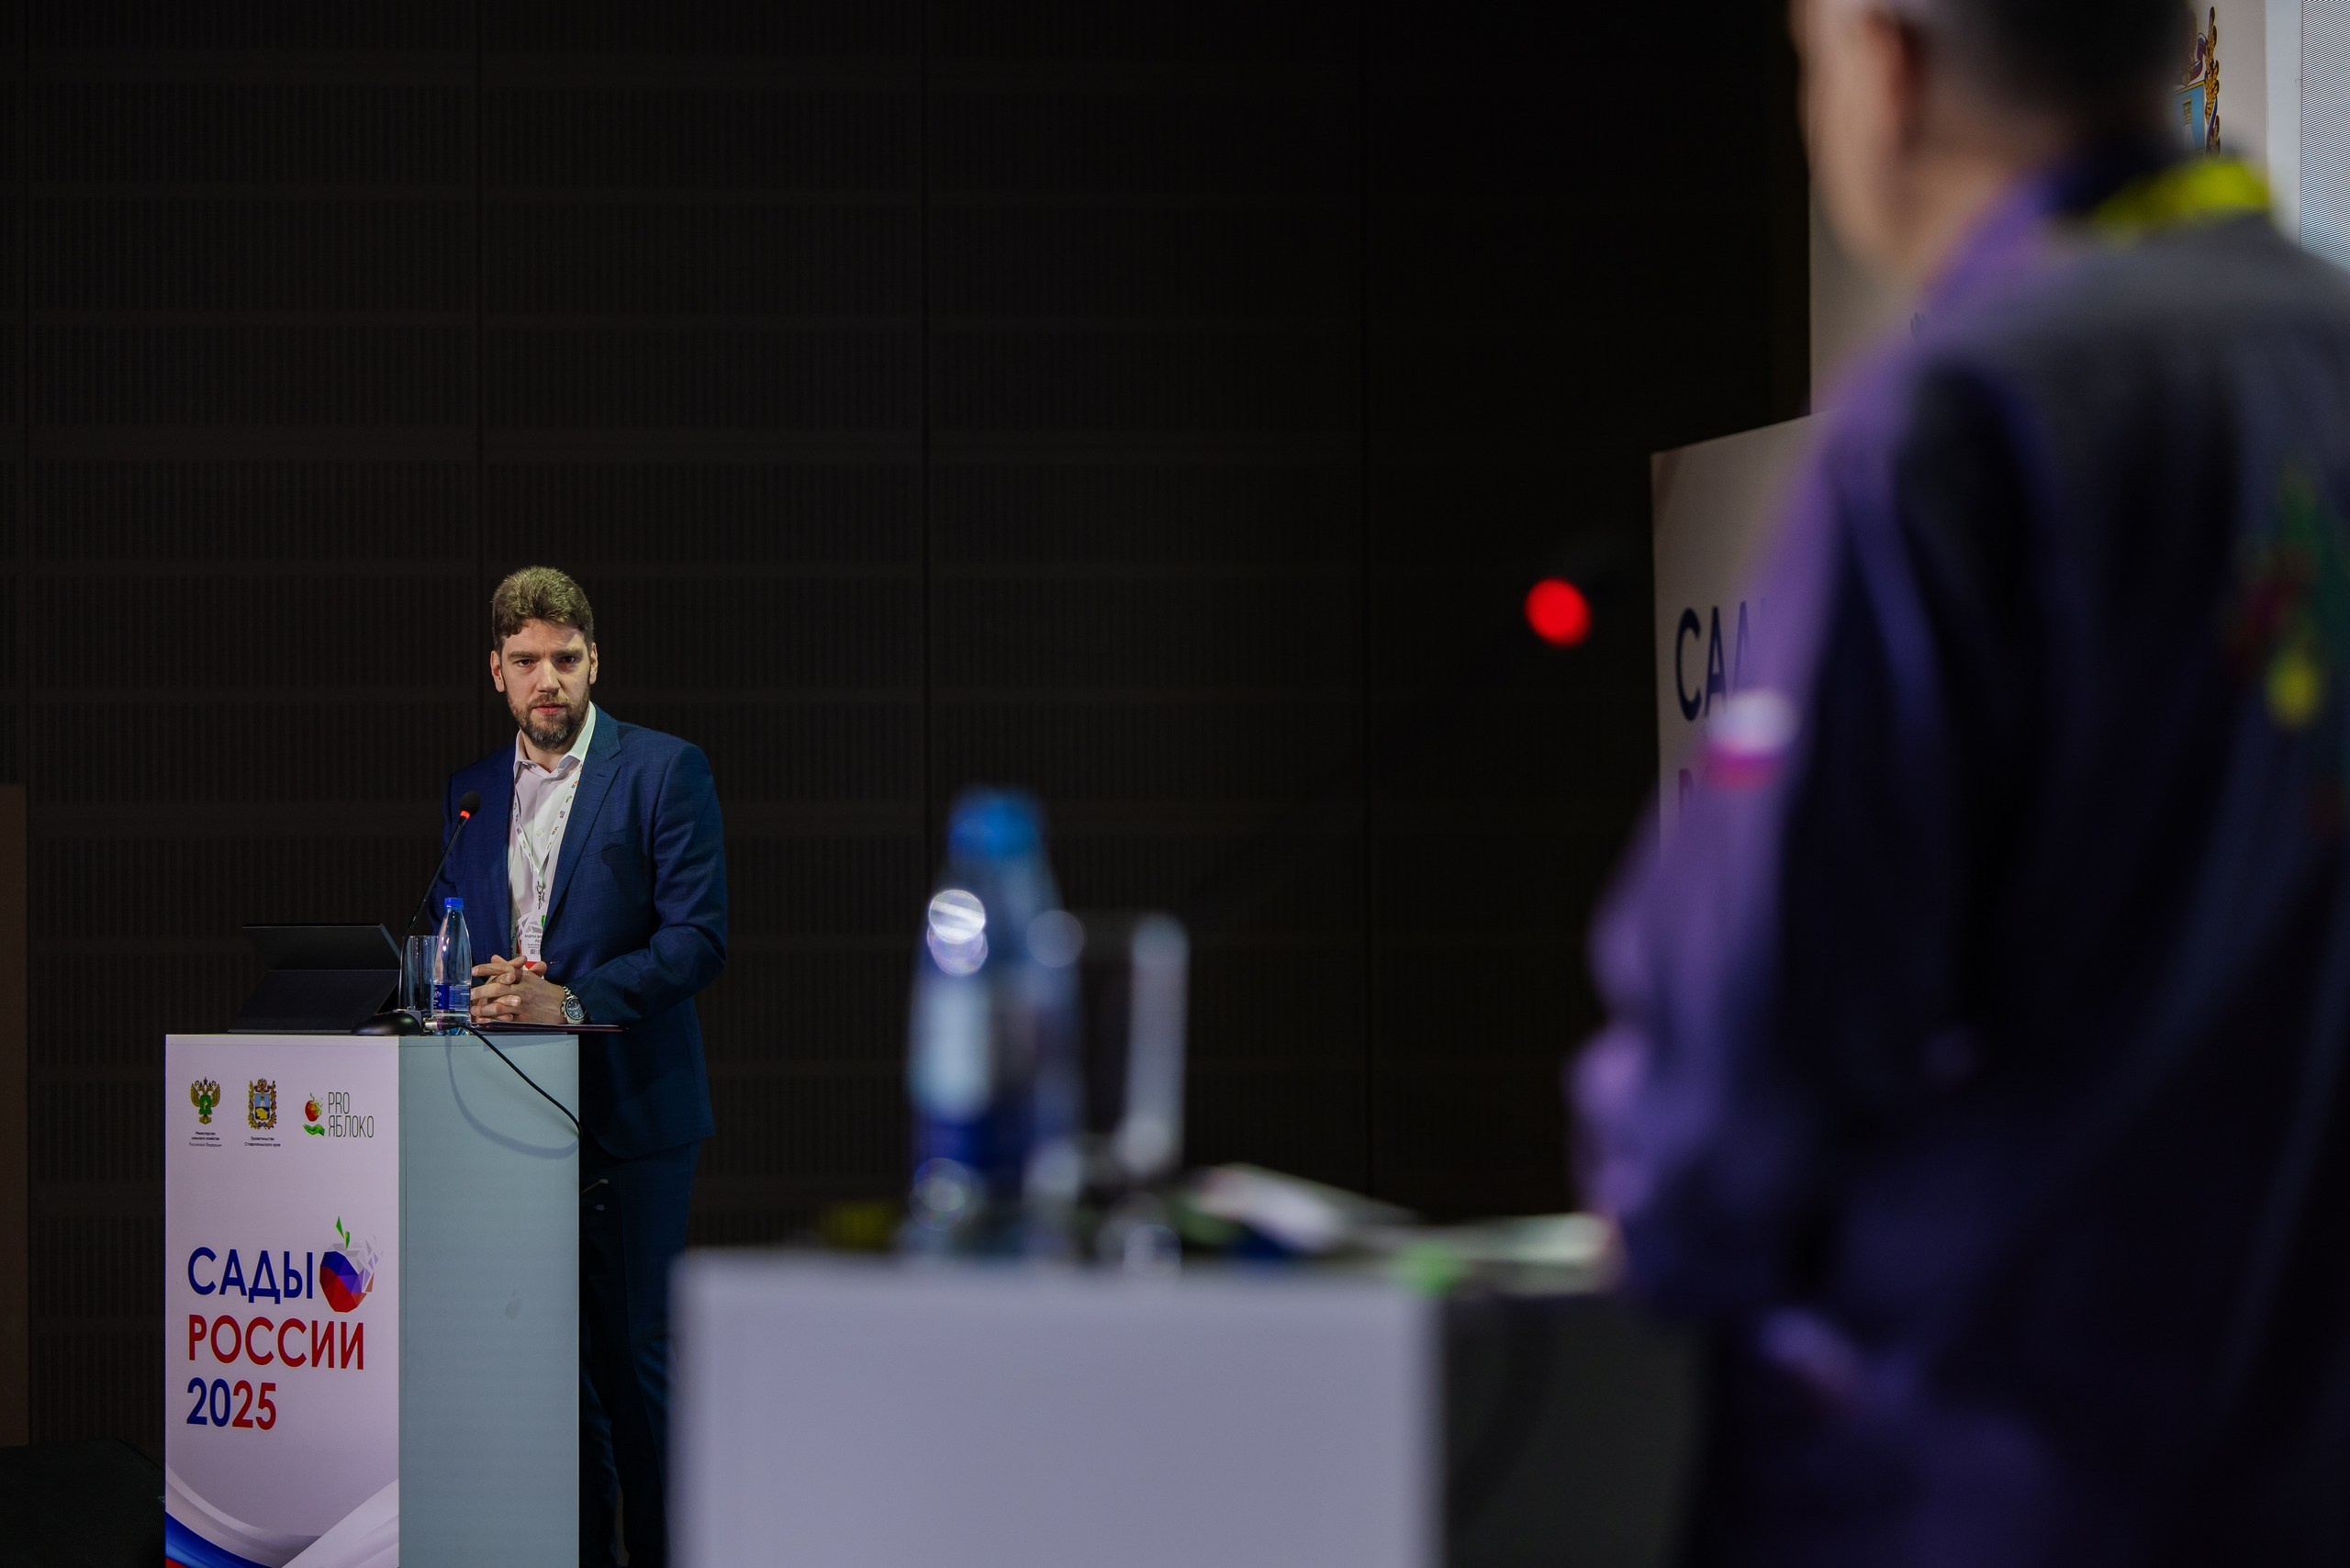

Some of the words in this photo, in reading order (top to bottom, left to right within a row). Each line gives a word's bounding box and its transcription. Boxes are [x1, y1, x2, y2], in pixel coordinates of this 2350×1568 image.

[328, 1092, 351, 1114] PRO
[328, 1114, 375, 1138] ЯБЛОКО
[187, 1246, 314, 1305] САДЫ
[188, 1314, 364, 1371] РОССИИ
[186, 1376, 277, 1430] 2025
